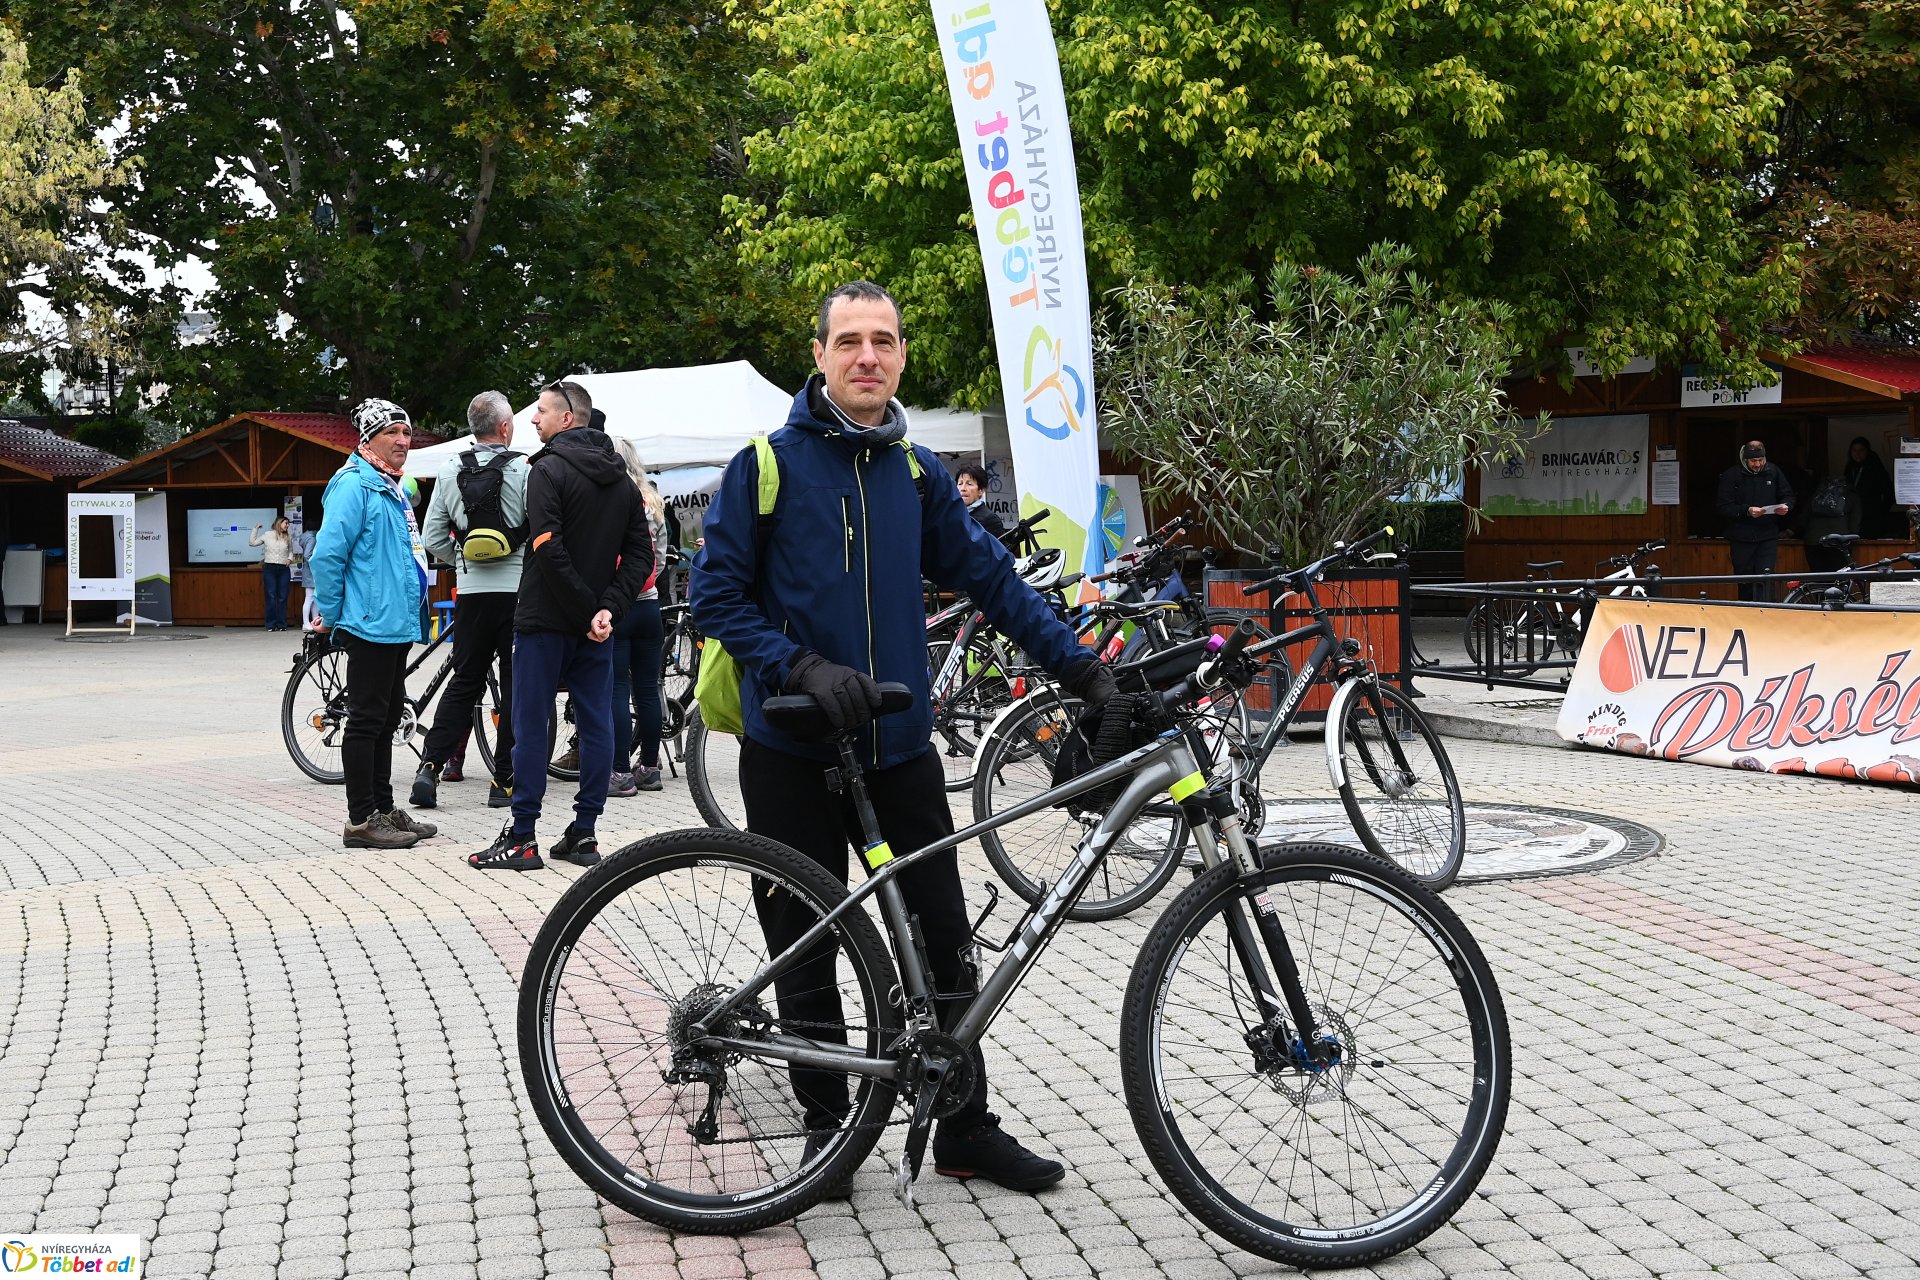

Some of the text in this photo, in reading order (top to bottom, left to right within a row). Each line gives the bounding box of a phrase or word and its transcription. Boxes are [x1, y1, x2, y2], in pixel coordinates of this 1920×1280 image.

[70, 500, 133, 508] CITYWALK 2.0
[70, 516, 78, 574] CITYWALK 2.0
[125, 517, 133, 575] CITYWALK 2.0
[1635, 624, 1749, 680] VELA
[1278, 663, 1315, 722] PEGASUS
[1587, 703, 1627, 727] MINDIG
[1585, 724, 1618, 737] Friss
[1009, 824, 1115, 961] TREK
